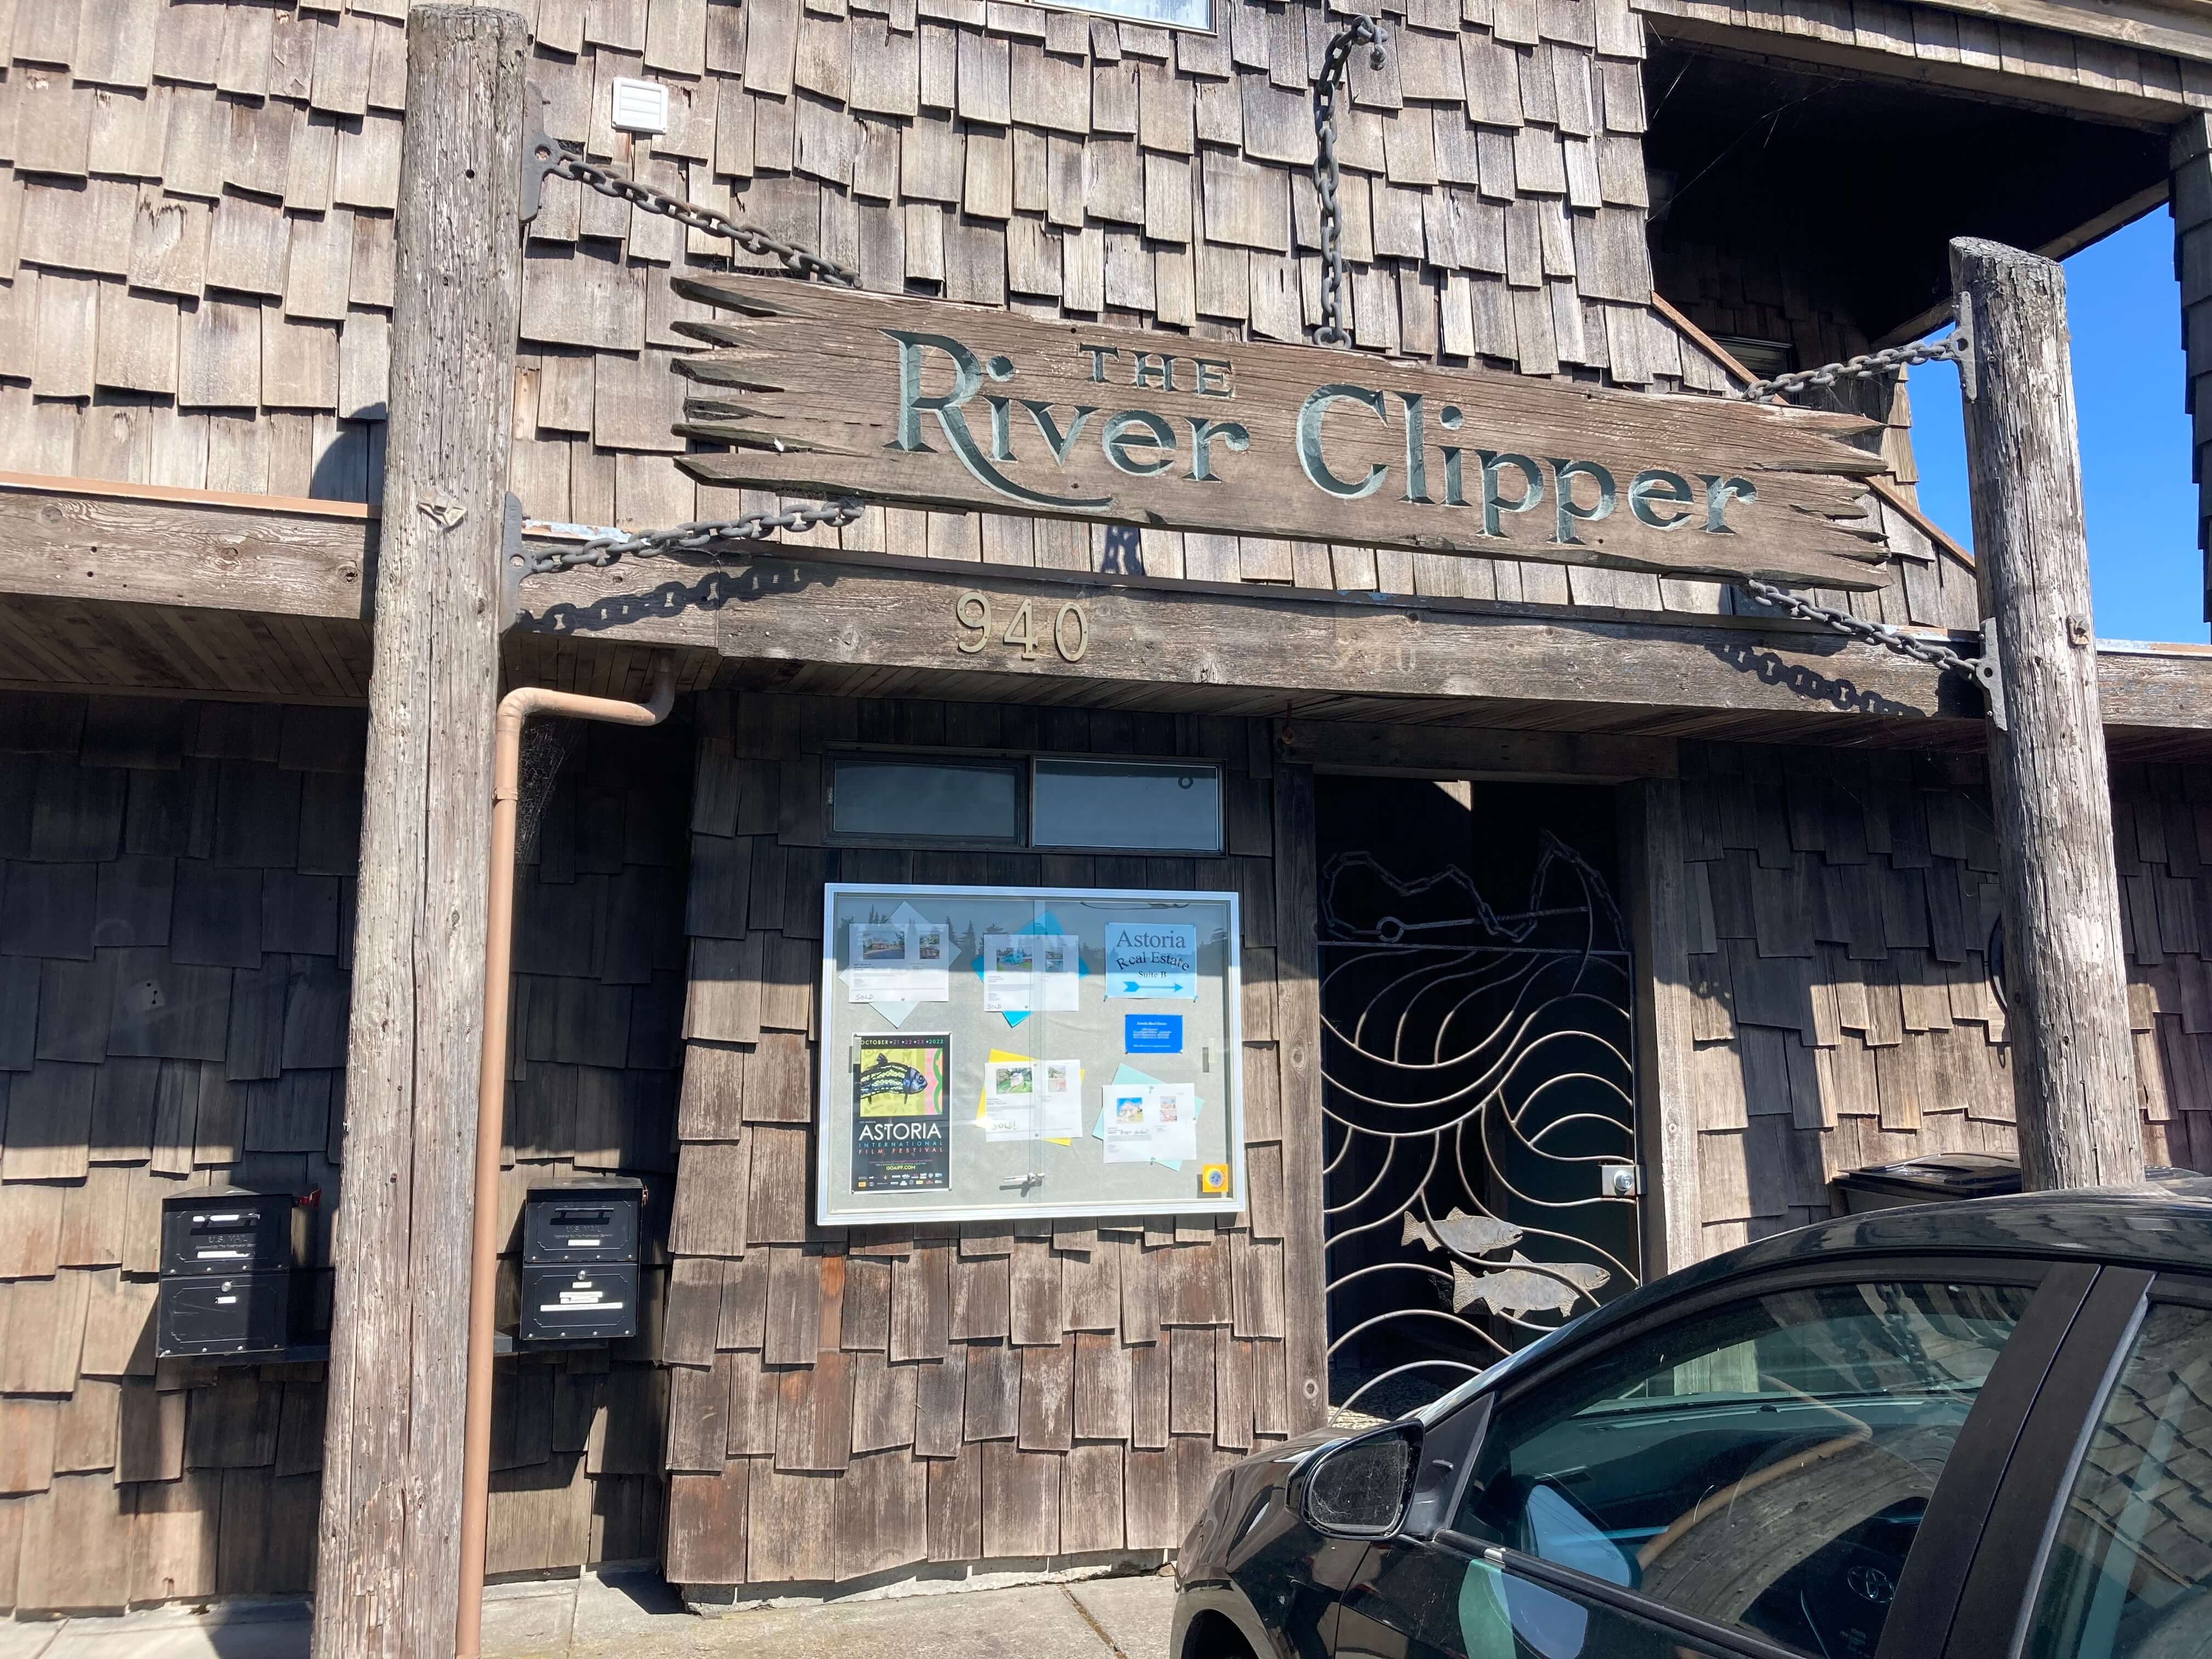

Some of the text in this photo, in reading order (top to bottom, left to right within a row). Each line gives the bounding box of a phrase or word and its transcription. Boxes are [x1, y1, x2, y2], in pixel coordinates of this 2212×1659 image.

[1078, 342, 1235, 399] THE
[878, 329, 1757, 546] River Clipper
[956, 591, 1089, 662] 940
[1116, 929, 1186, 949] Astoria
[1116, 951, 1189, 971] Real Estate
[859, 1122, 942, 1141] ASTORIA
